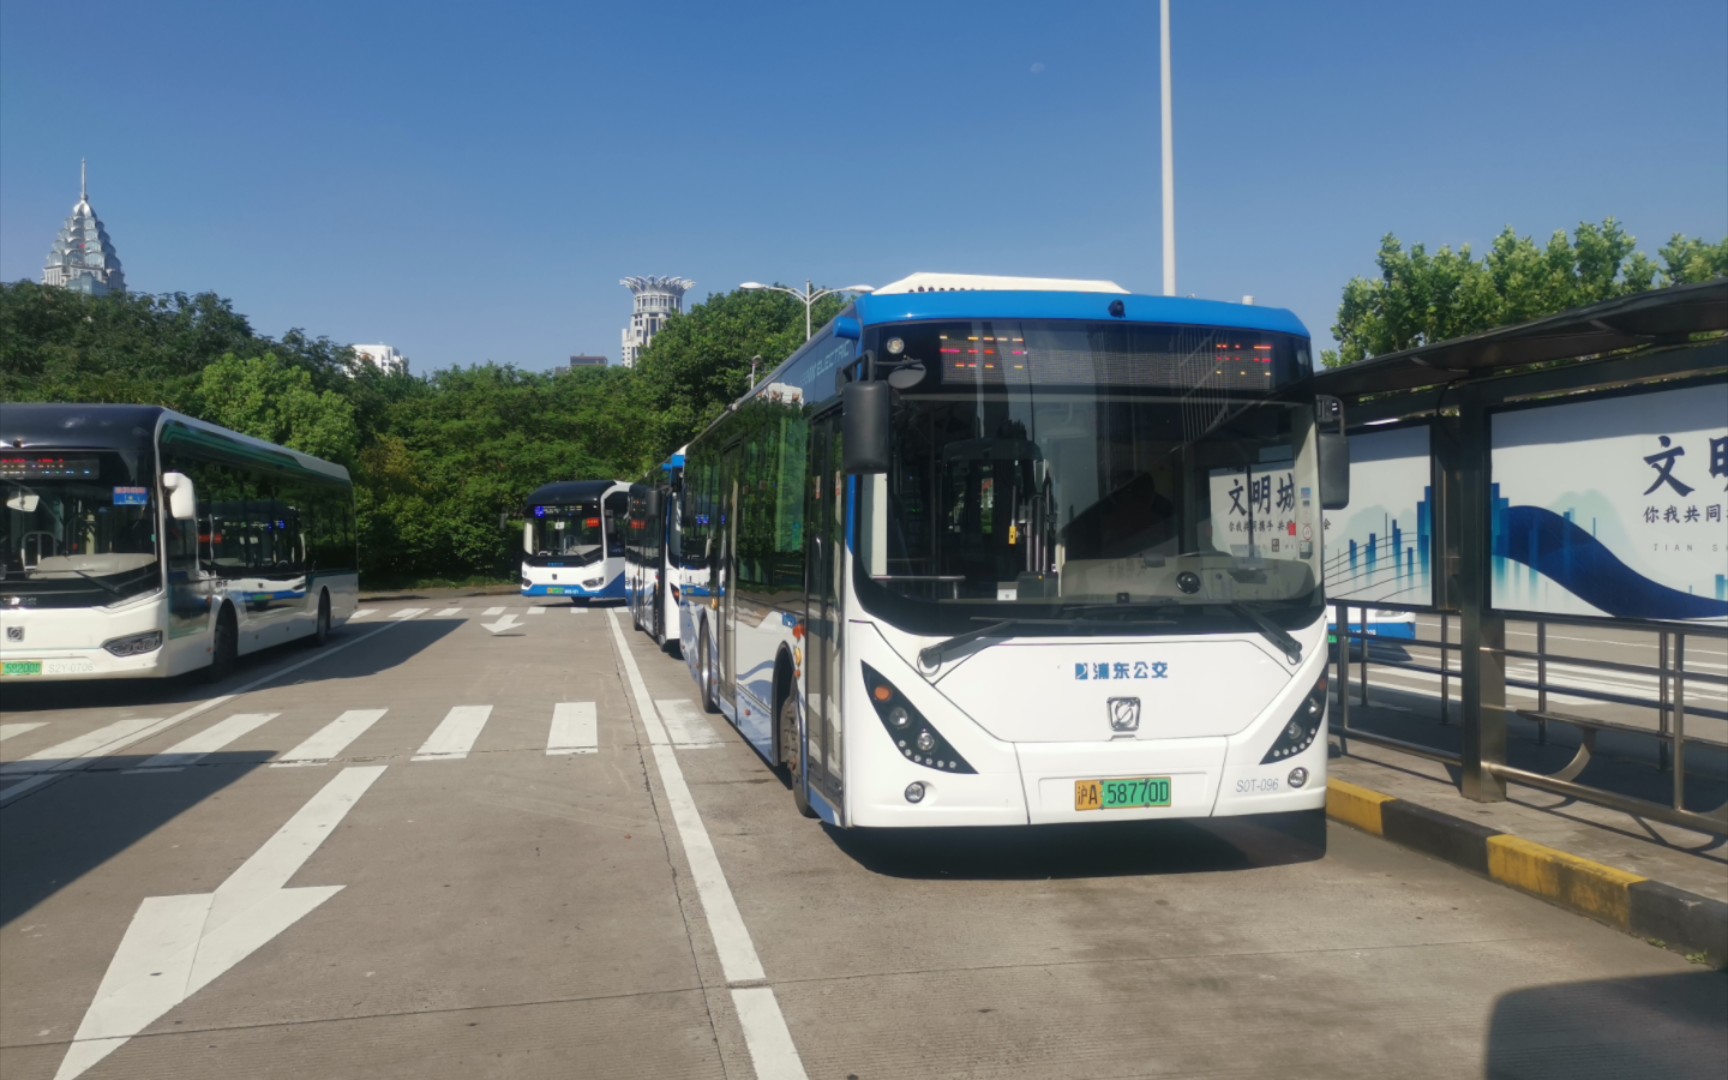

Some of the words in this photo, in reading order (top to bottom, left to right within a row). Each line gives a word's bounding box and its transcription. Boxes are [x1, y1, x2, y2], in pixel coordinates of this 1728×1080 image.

[1643, 504, 1728, 523] 你我共同
[1093, 661, 1168, 680] 浦东公交
